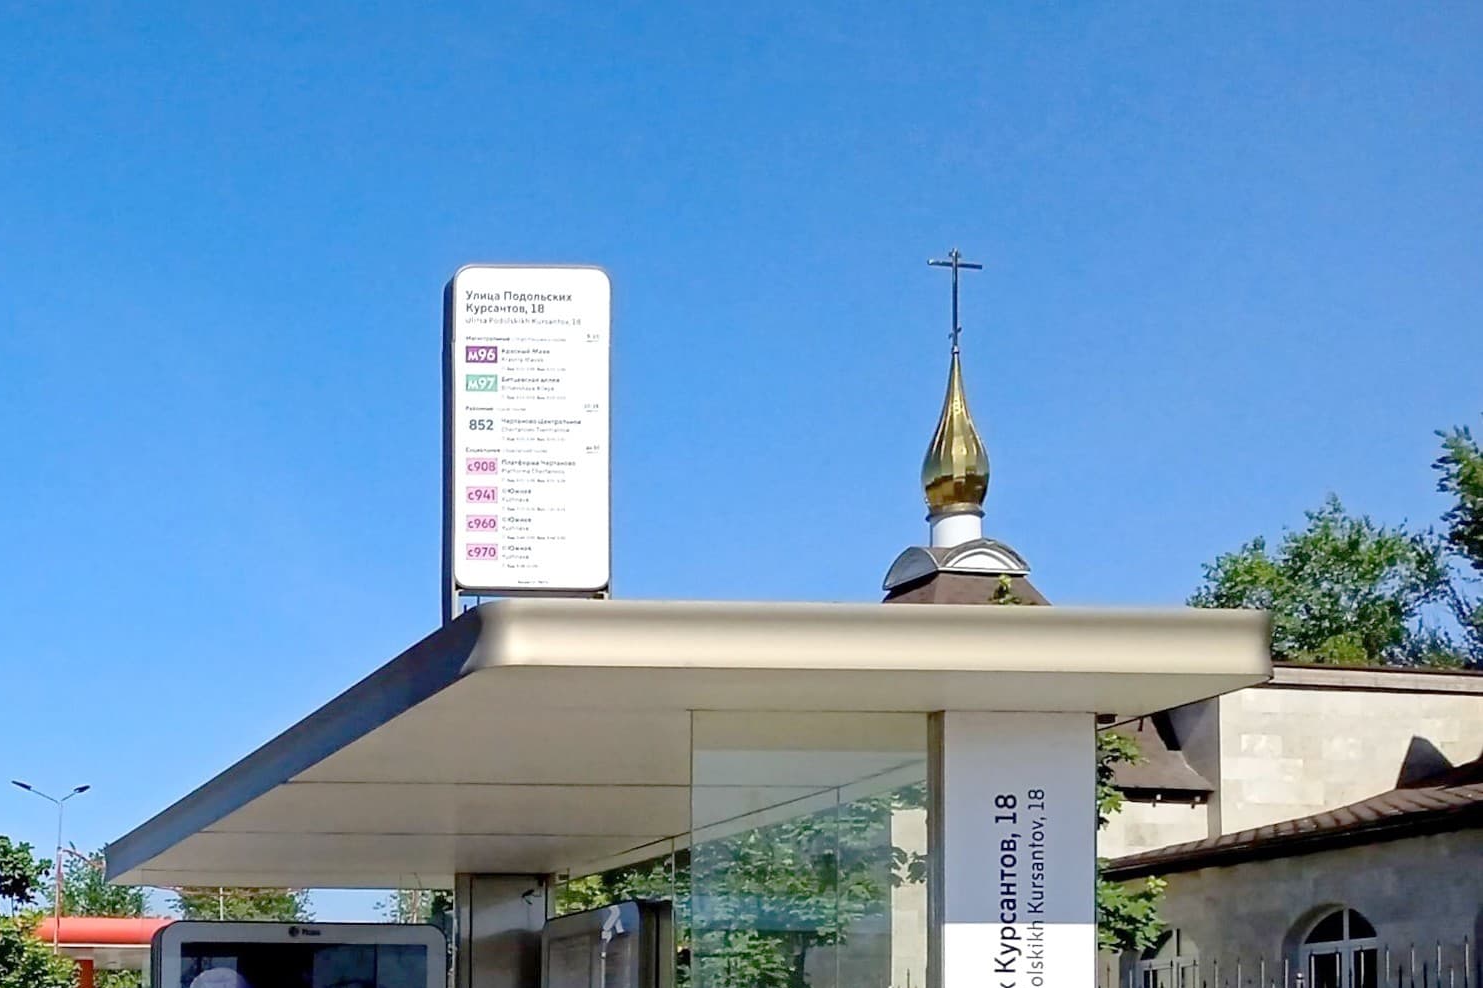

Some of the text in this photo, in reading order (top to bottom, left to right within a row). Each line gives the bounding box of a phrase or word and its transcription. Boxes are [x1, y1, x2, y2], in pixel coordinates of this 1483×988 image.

[465, 290, 572, 302] Улица Подольских
[465, 303, 545, 315] Курсантов, 18
[469, 419, 494, 431] 852
[994, 794, 1017, 824] 18
[1027, 789, 1045, 811] 18
[1027, 817, 1047, 914] Kursantov,
[993, 833, 1022, 973] Курсантов,
